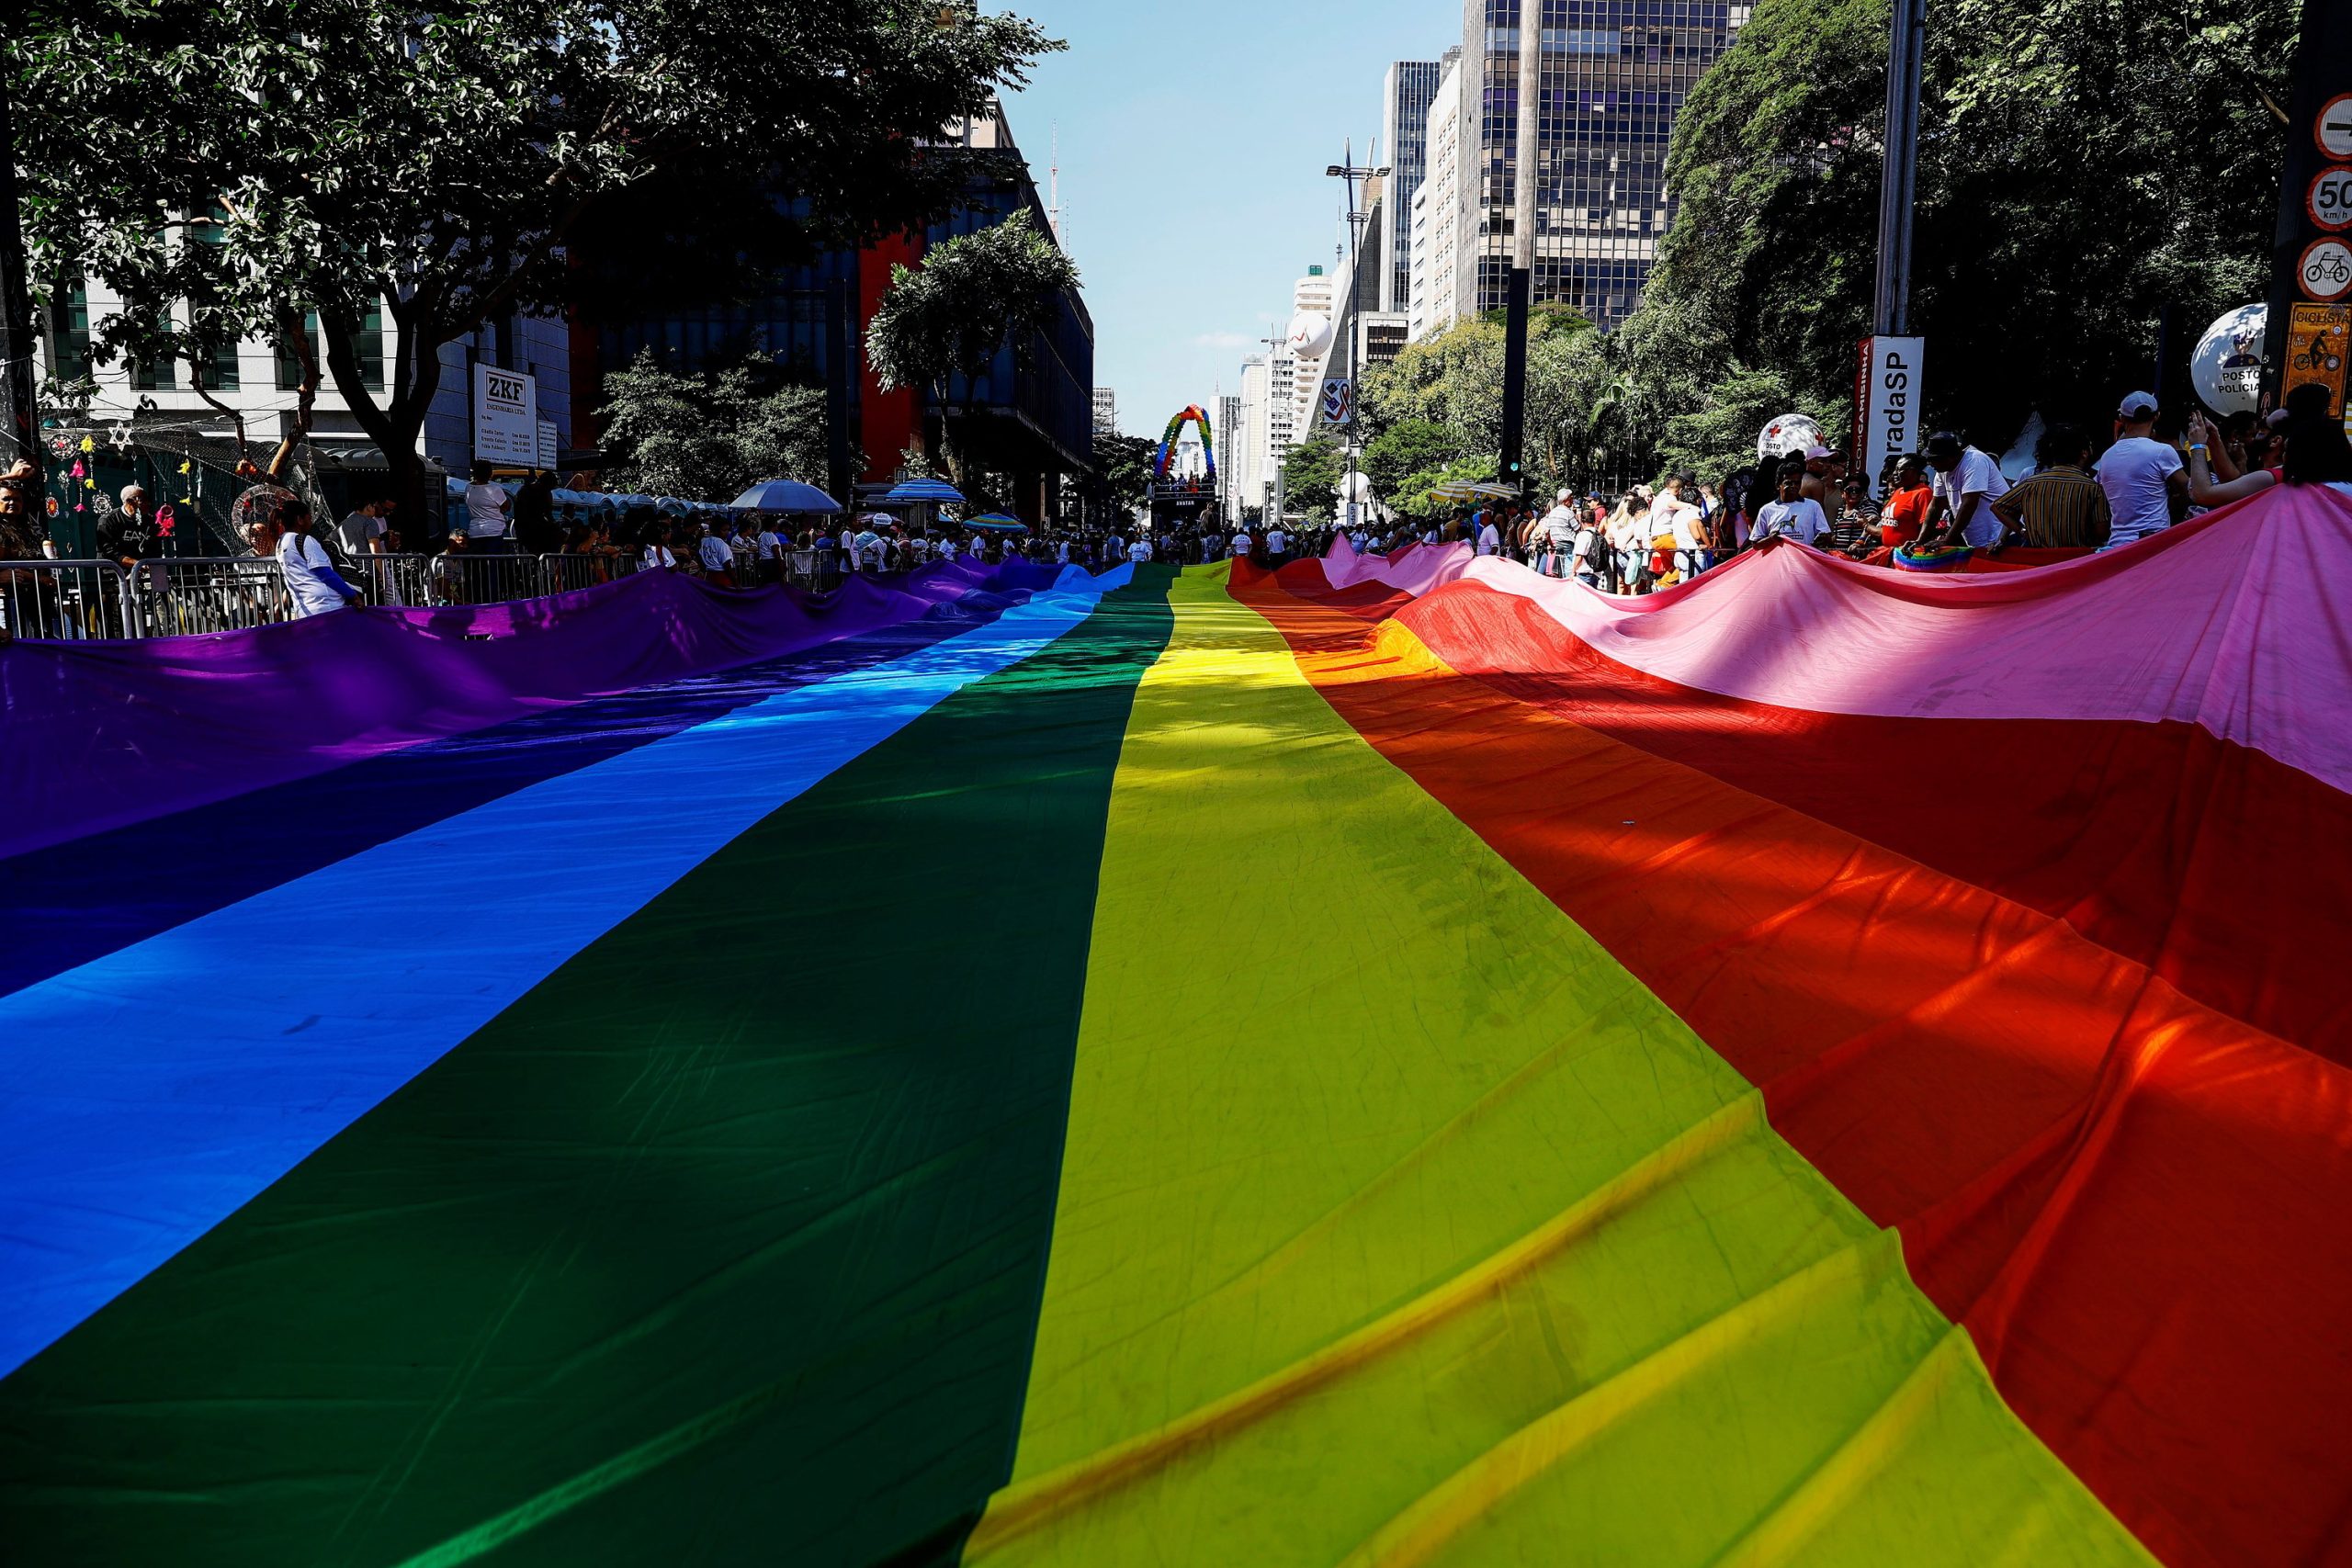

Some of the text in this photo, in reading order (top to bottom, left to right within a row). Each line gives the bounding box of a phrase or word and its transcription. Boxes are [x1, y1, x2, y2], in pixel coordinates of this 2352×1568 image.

[2318, 181, 2352, 209] 50
[2296, 311, 2352, 323] CICLISTA
[2222, 370, 2260, 381] POSTO
[488, 377, 524, 401] ZKF
[1855, 343, 1870, 474] COMCAMISINHA
